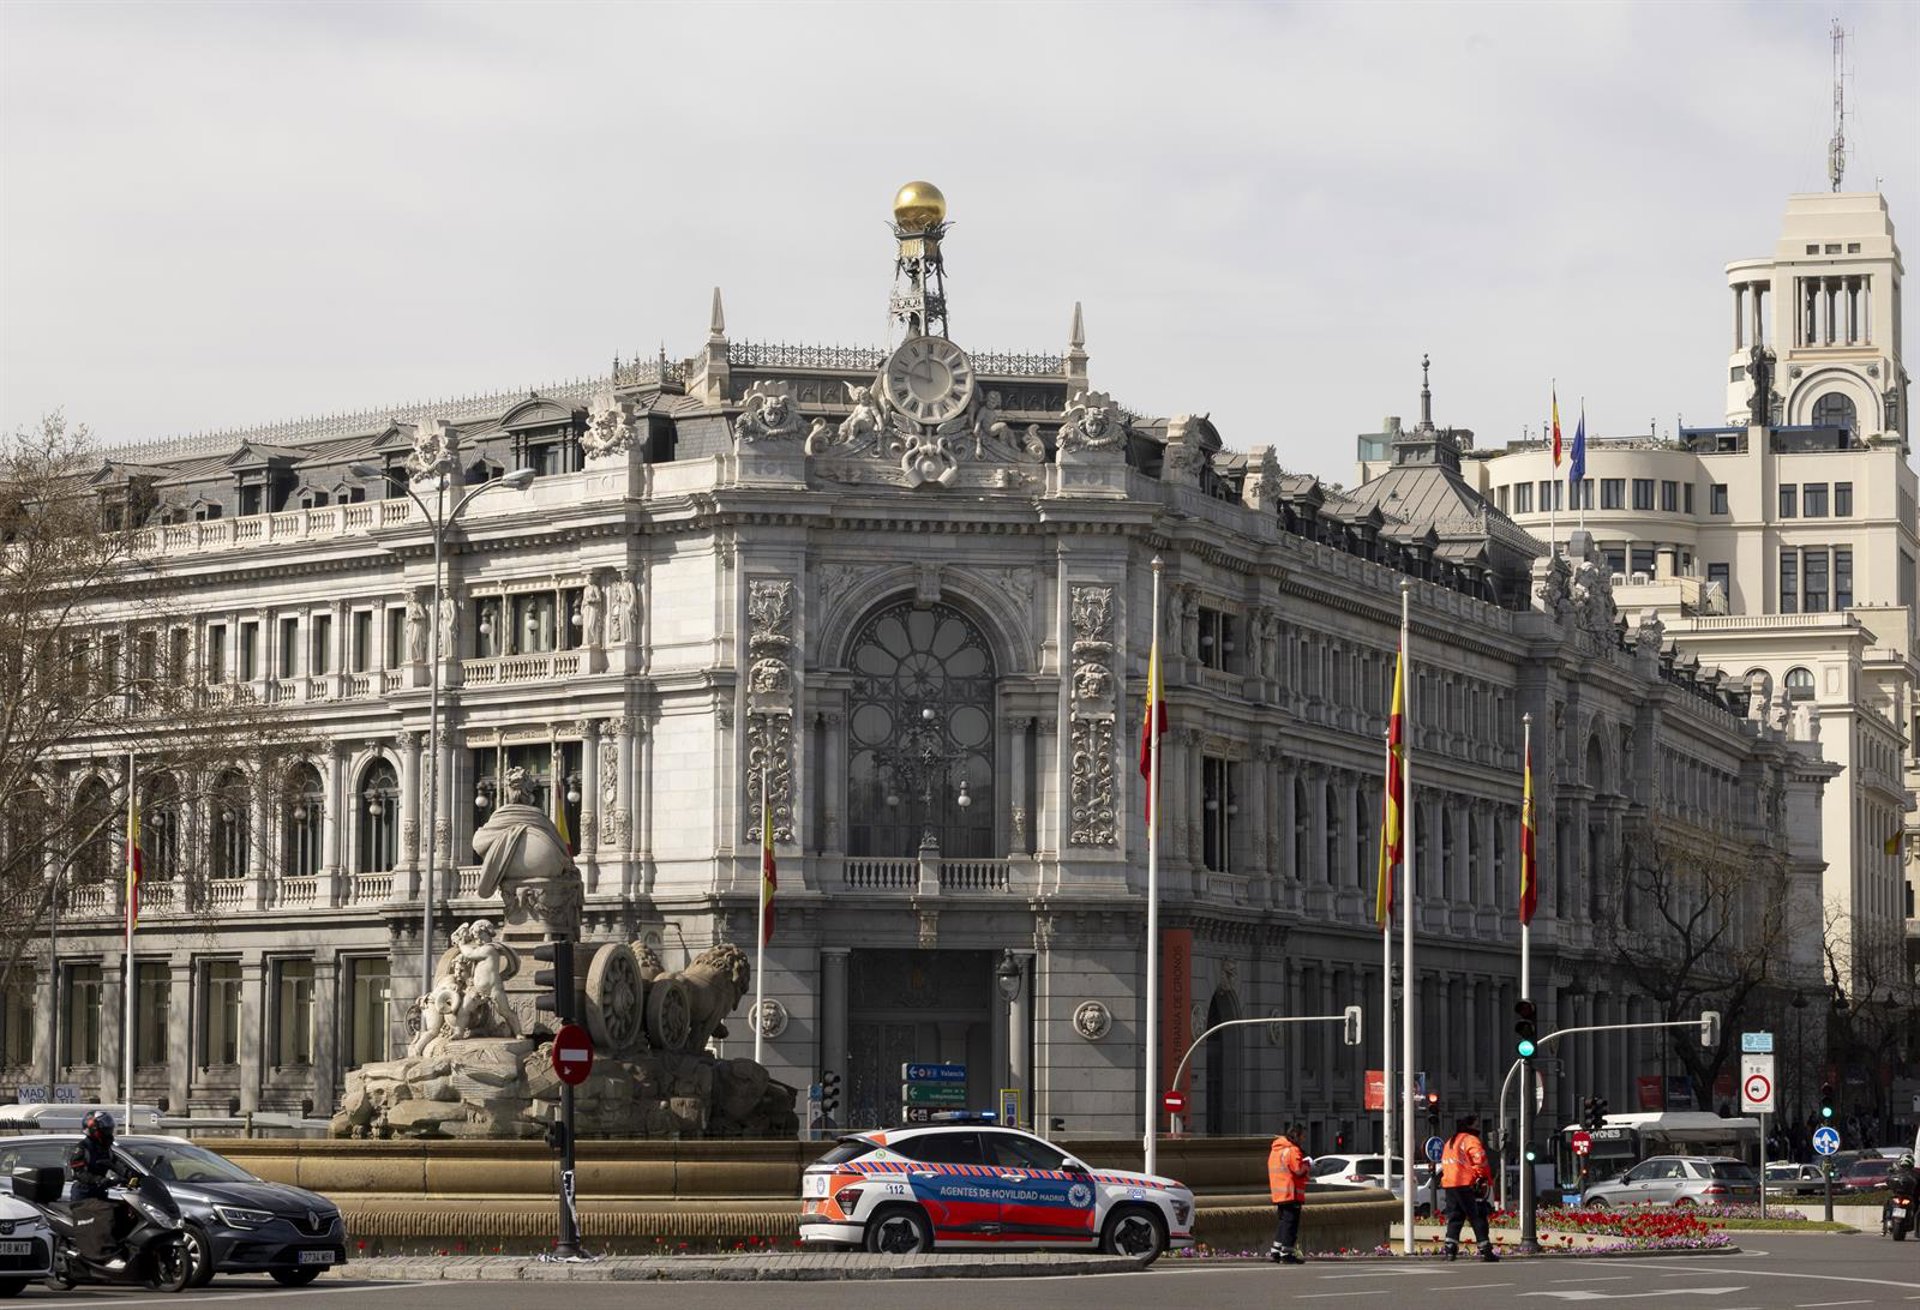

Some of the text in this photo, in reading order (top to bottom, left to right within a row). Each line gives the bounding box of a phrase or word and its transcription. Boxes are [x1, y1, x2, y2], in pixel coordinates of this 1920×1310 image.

[940, 1069, 964, 1077] Valencia
[19, 1088, 76, 1098] MAD CUL
[889, 1185, 905, 1195] 112
[940, 1186, 1065, 1202] AGENTES DE MOVILIDAD MADRID
